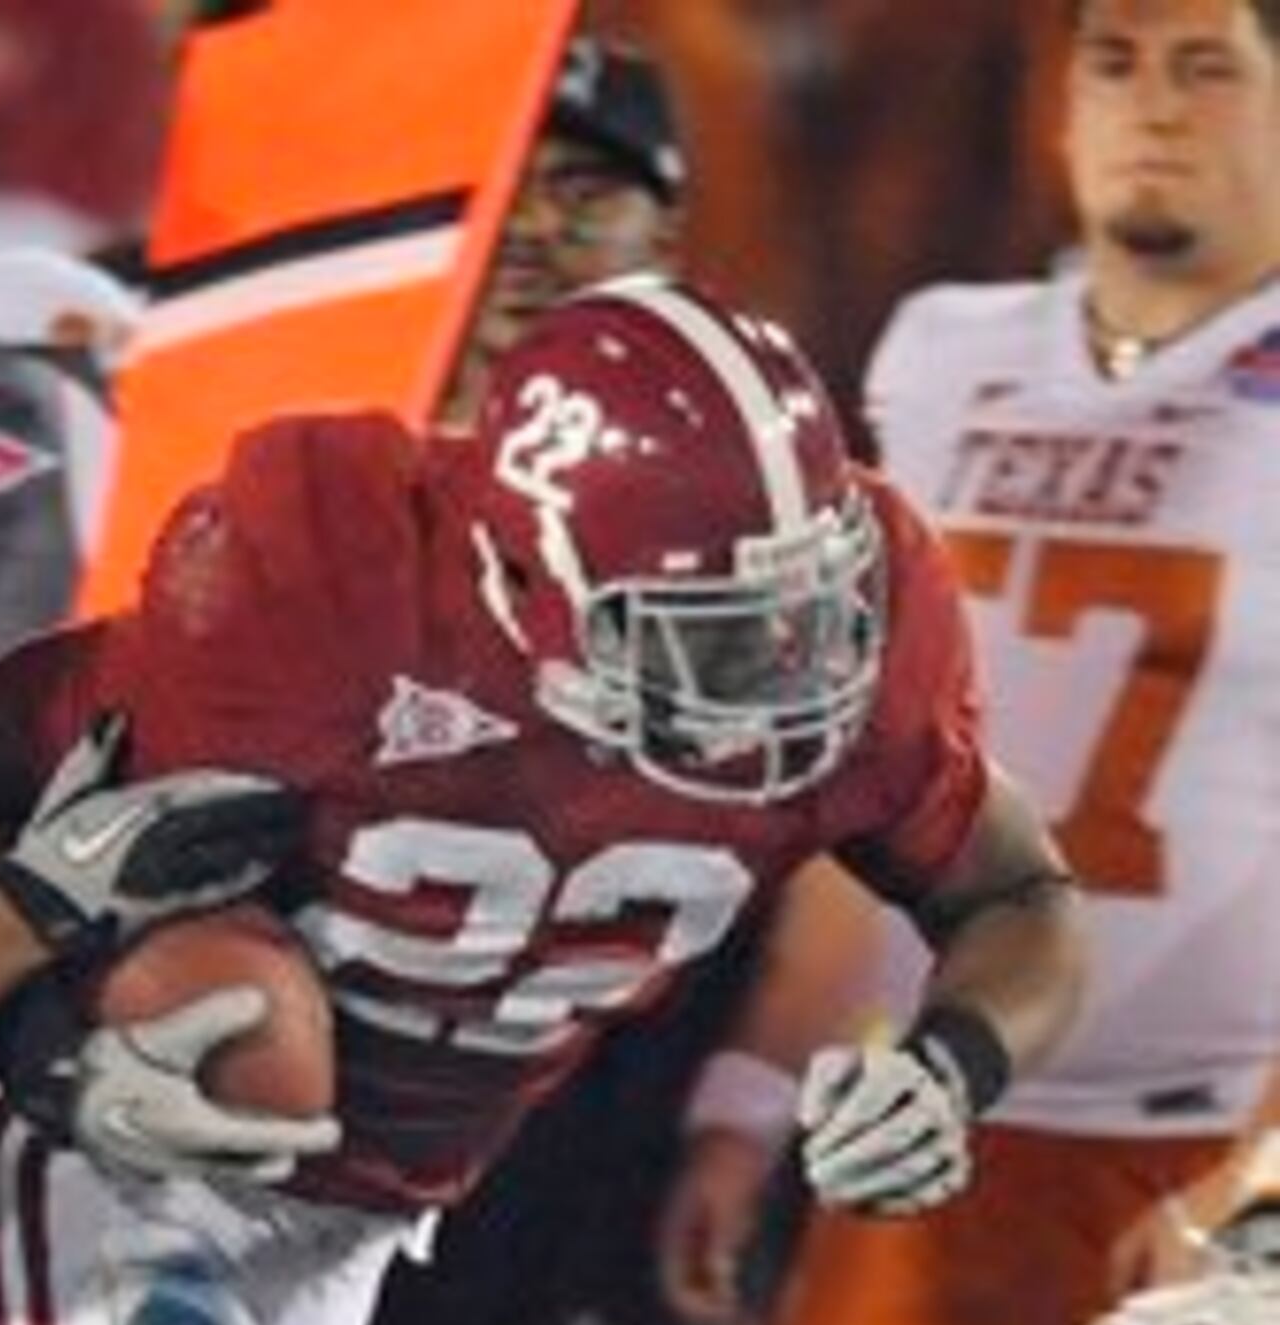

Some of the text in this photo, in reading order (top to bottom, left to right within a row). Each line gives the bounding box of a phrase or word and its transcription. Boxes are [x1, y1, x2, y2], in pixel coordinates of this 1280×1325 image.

[495, 373, 603, 510] 22
[938, 429, 1182, 526] TEXAS
[296, 818, 755, 1055] 22
